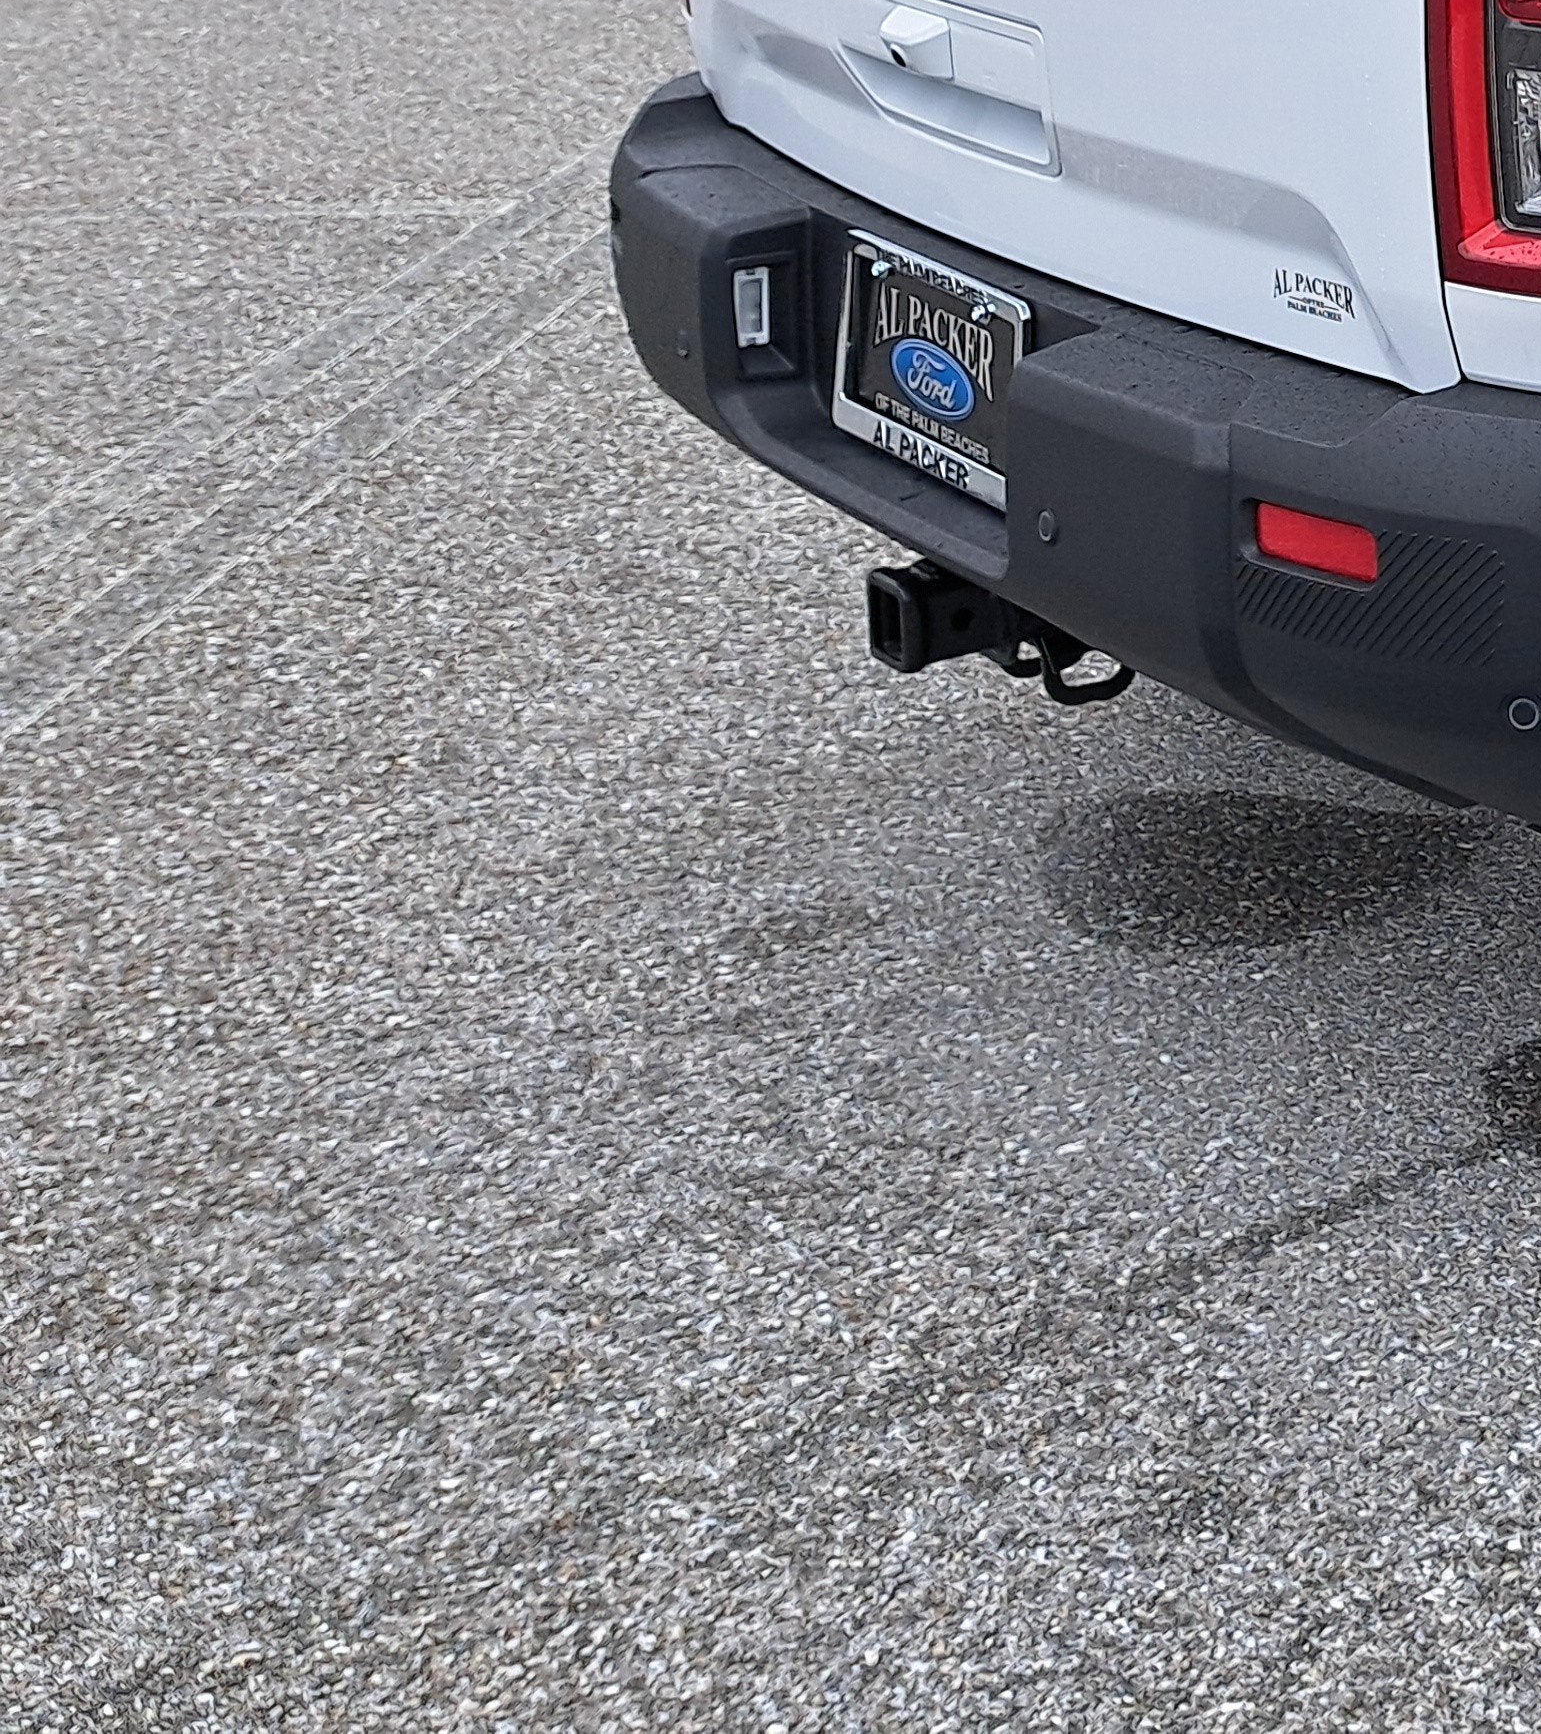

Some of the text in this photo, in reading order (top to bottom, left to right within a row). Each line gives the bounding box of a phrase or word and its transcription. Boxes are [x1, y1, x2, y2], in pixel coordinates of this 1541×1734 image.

[1274, 268, 1356, 320] AL PACKER
[1287, 300, 1307, 313] PALM
[873, 282, 995, 403] AL PACKER
[907, 349, 957, 410] Ford
[873, 419, 970, 490] AL PACKER
[875, 392, 990, 464] OF THE PALM BEACHES
